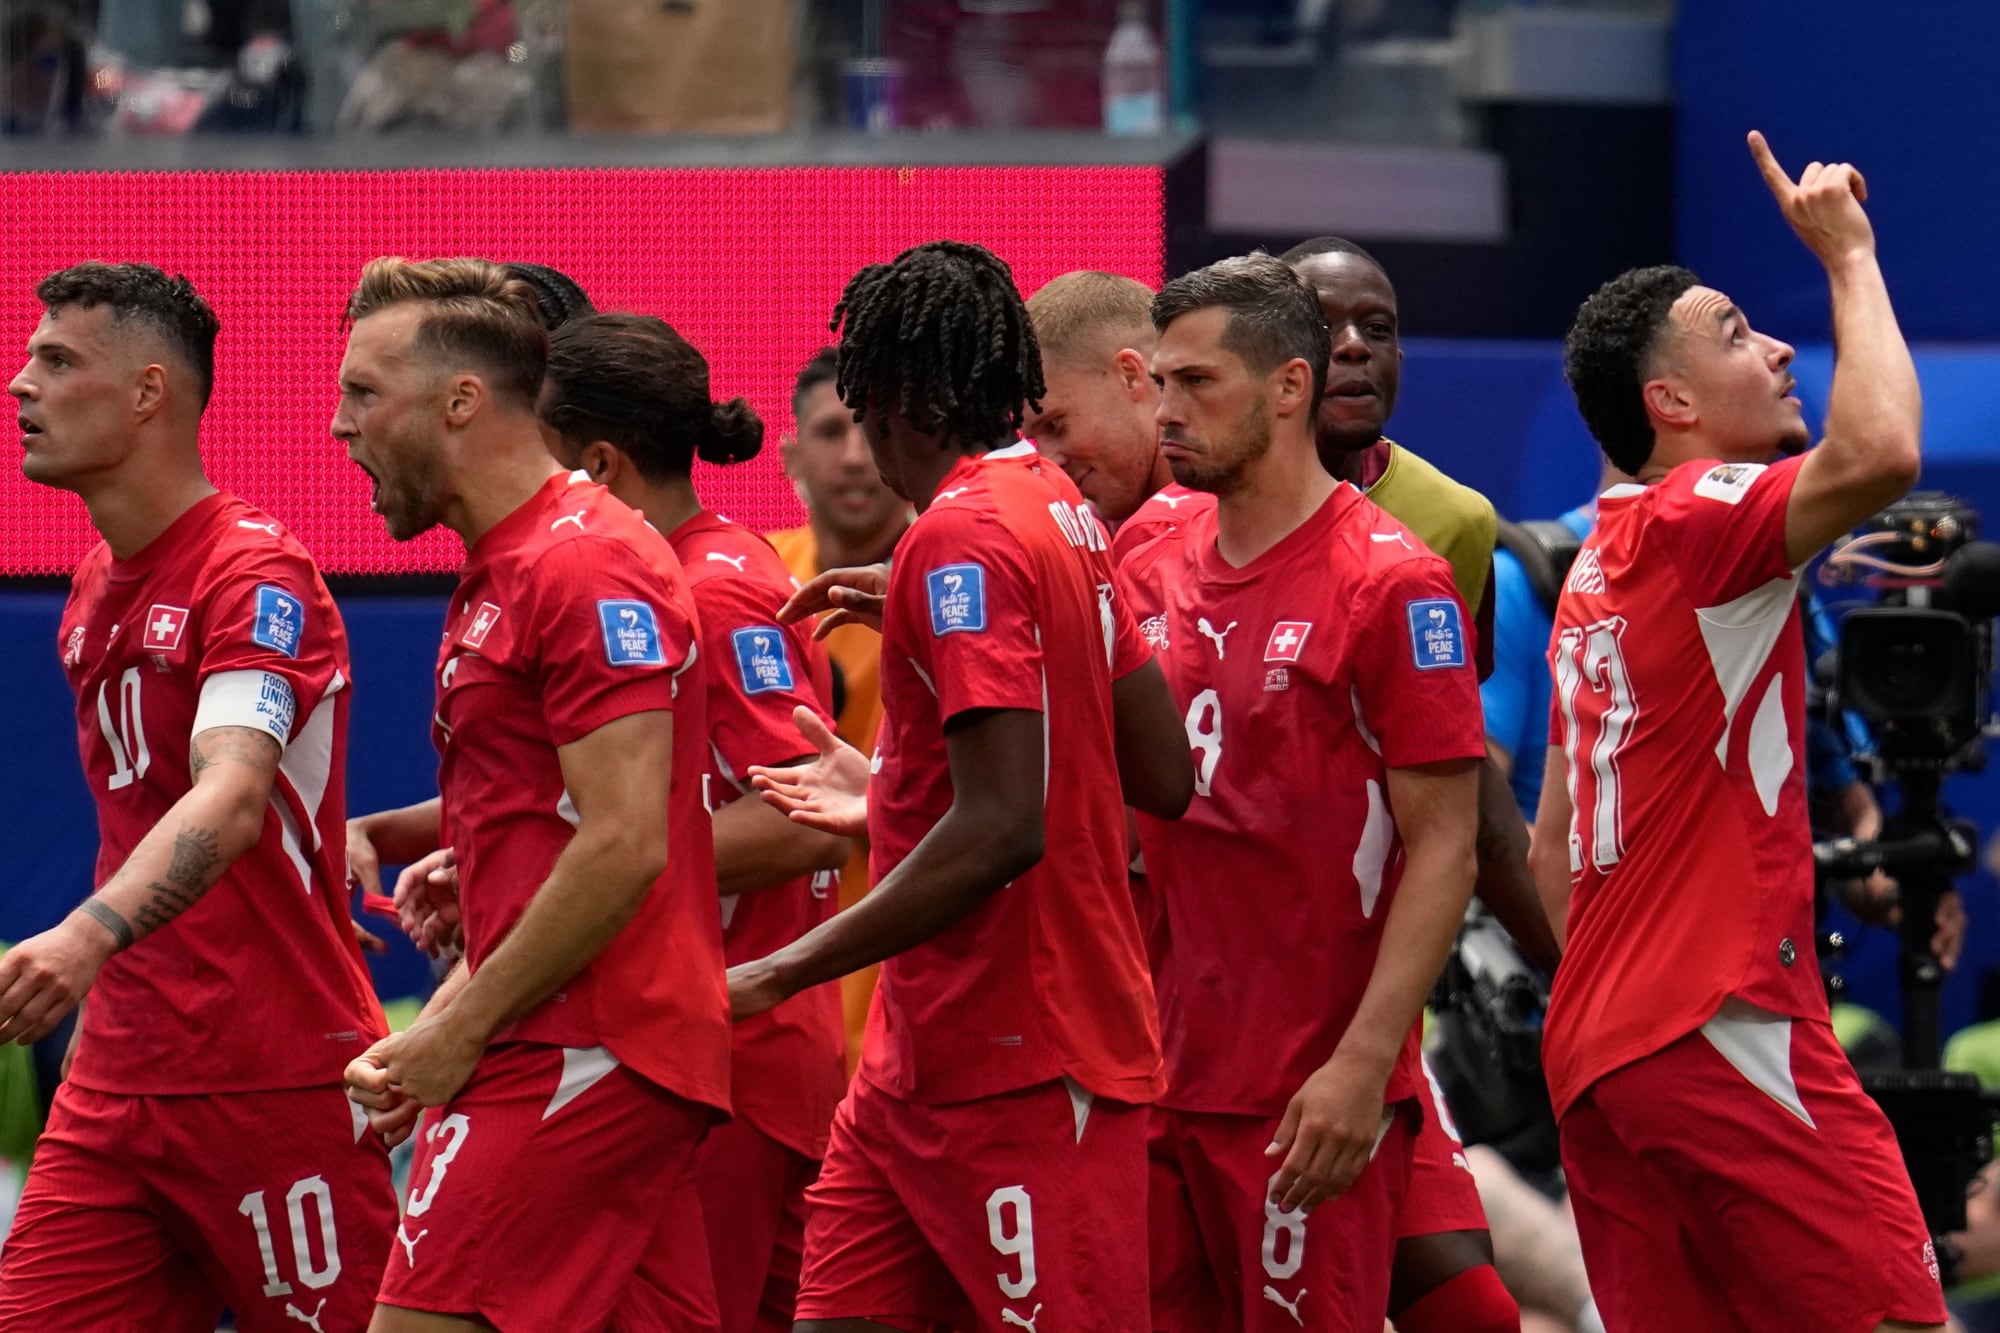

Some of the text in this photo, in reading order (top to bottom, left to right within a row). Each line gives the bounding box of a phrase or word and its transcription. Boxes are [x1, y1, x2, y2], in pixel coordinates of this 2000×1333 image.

[942, 604, 969, 619] PEACE
[269, 625, 292, 644] PEACE
[1425, 628, 1444, 641] Unite
[621, 639, 648, 652] PEACE
[1428, 641, 1454, 654] PEACE
[756, 665, 781, 679] PEACE
[255, 701, 273, 715] the
[98, 666, 151, 790] 10
[1556, 614, 1639, 885] 17
[407, 1112, 471, 1218] 3
[1262, 1170, 1308, 1279] 8
[238, 1174, 341, 1297] 10
[986, 1185, 1037, 1299] 9
